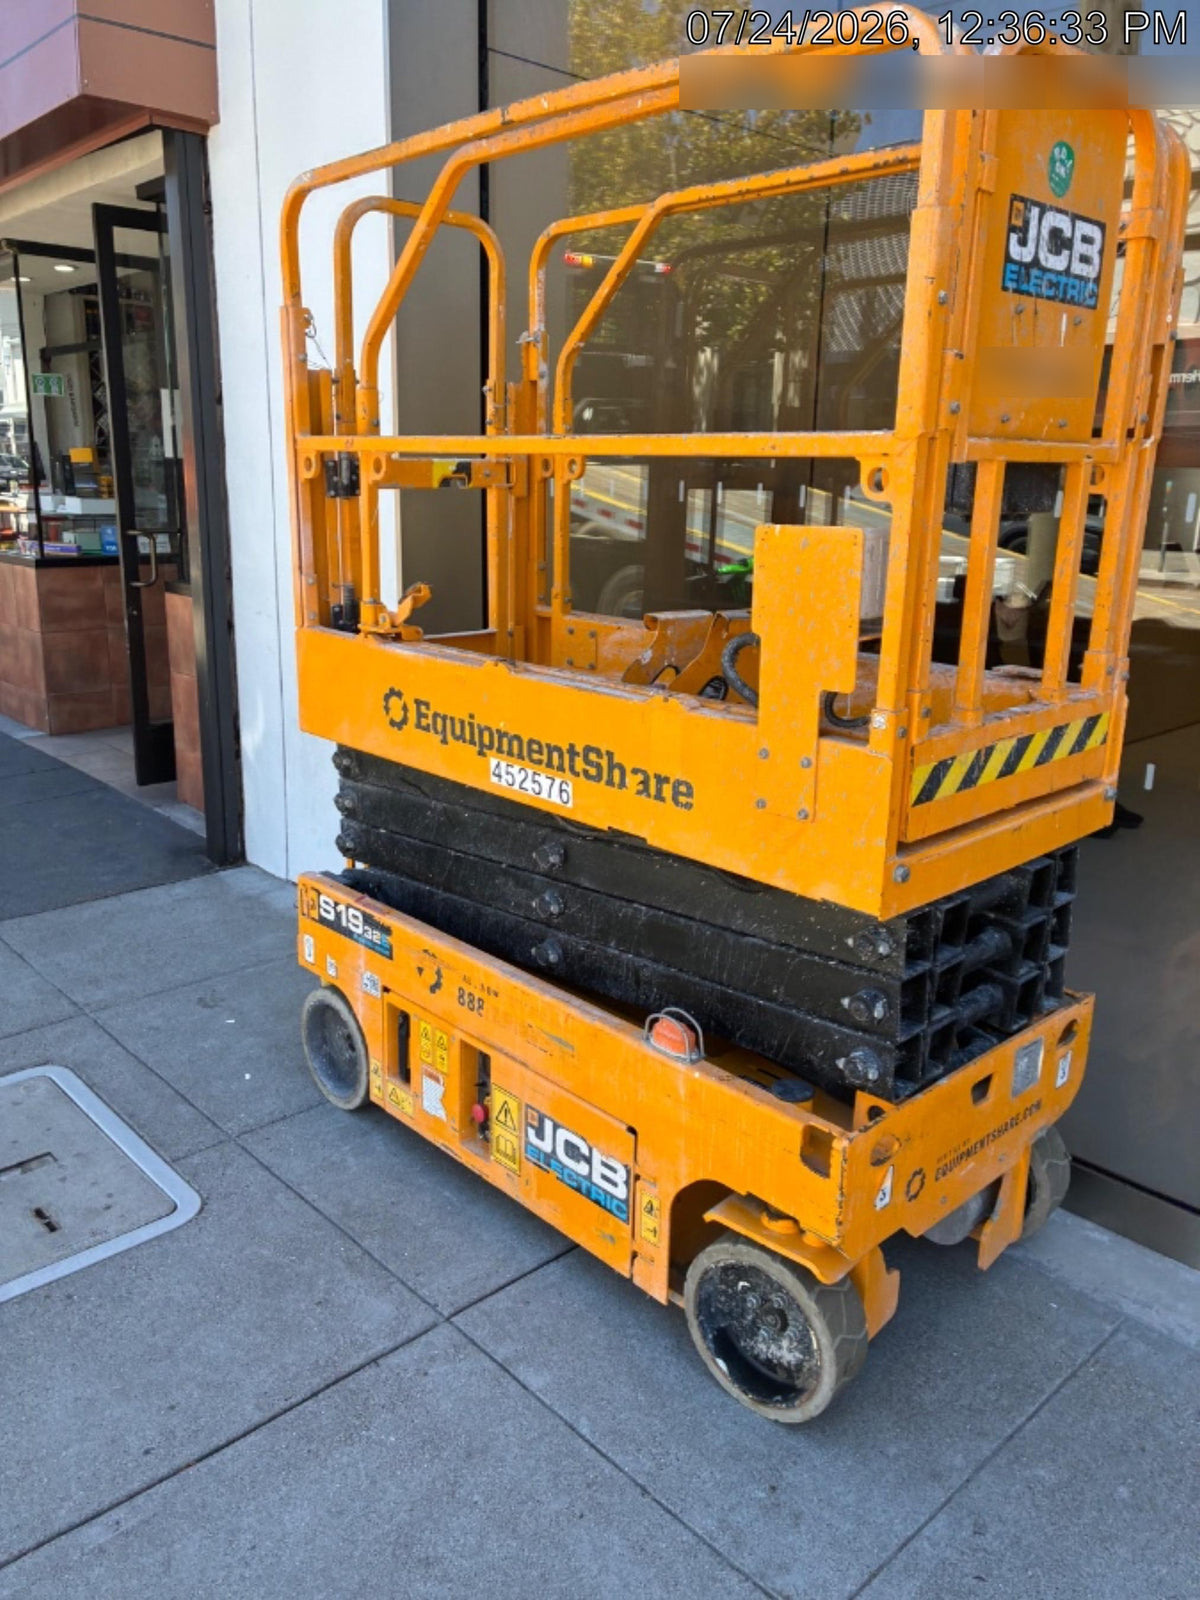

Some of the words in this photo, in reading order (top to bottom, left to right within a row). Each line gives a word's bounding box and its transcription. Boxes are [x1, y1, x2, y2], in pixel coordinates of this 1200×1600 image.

[1008, 204, 1103, 279] JCB
[1003, 262, 1098, 305] ELECTRIC
[412, 697, 694, 811] EquipmentShare
[491, 759, 570, 805] 452576
[525, 1142, 628, 1222] ELECTRIC
[526, 1116, 628, 1201] JCB
